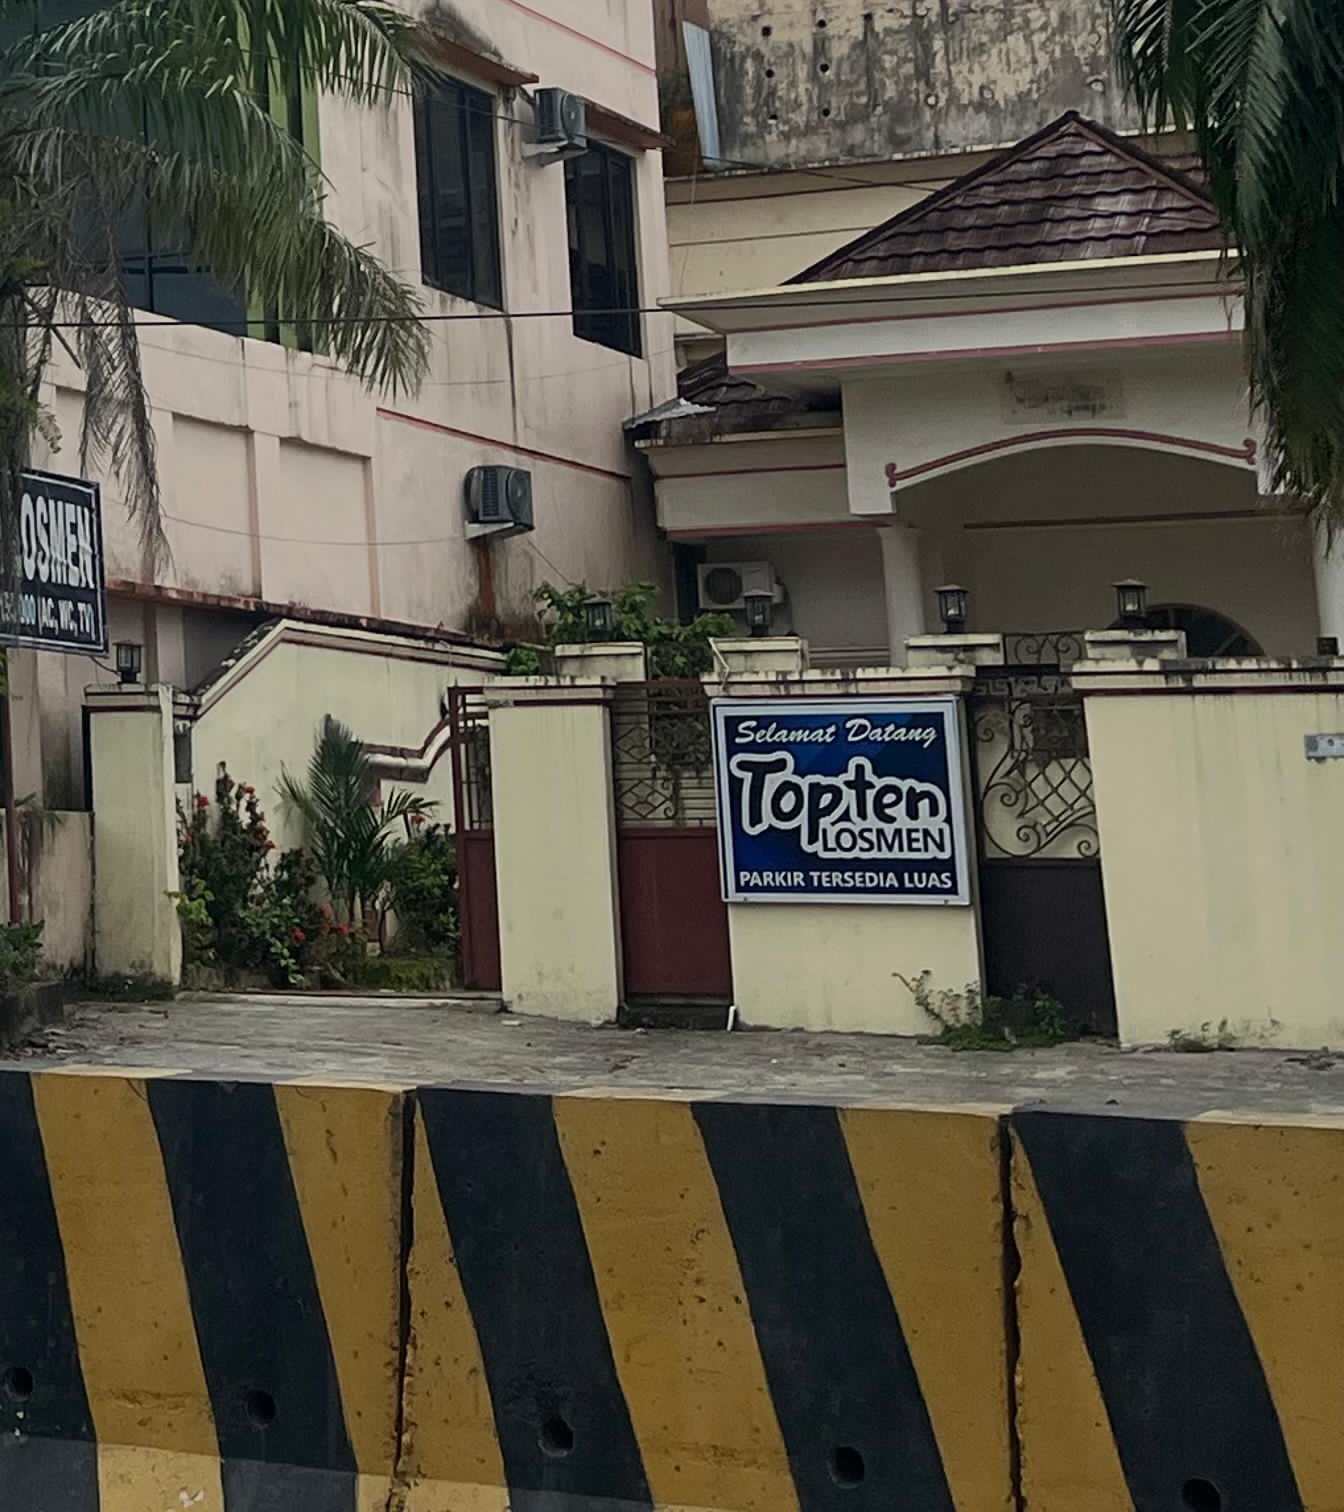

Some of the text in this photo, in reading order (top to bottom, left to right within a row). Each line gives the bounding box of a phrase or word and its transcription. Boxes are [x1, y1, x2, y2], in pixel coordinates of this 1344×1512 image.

[17, 492, 96, 589] OSMEN
[734, 718, 938, 749] Selamat Datang
[821, 827, 946, 854] LOSMEN
[740, 870, 953, 889] PARKIR TERSEDIA LUAS
